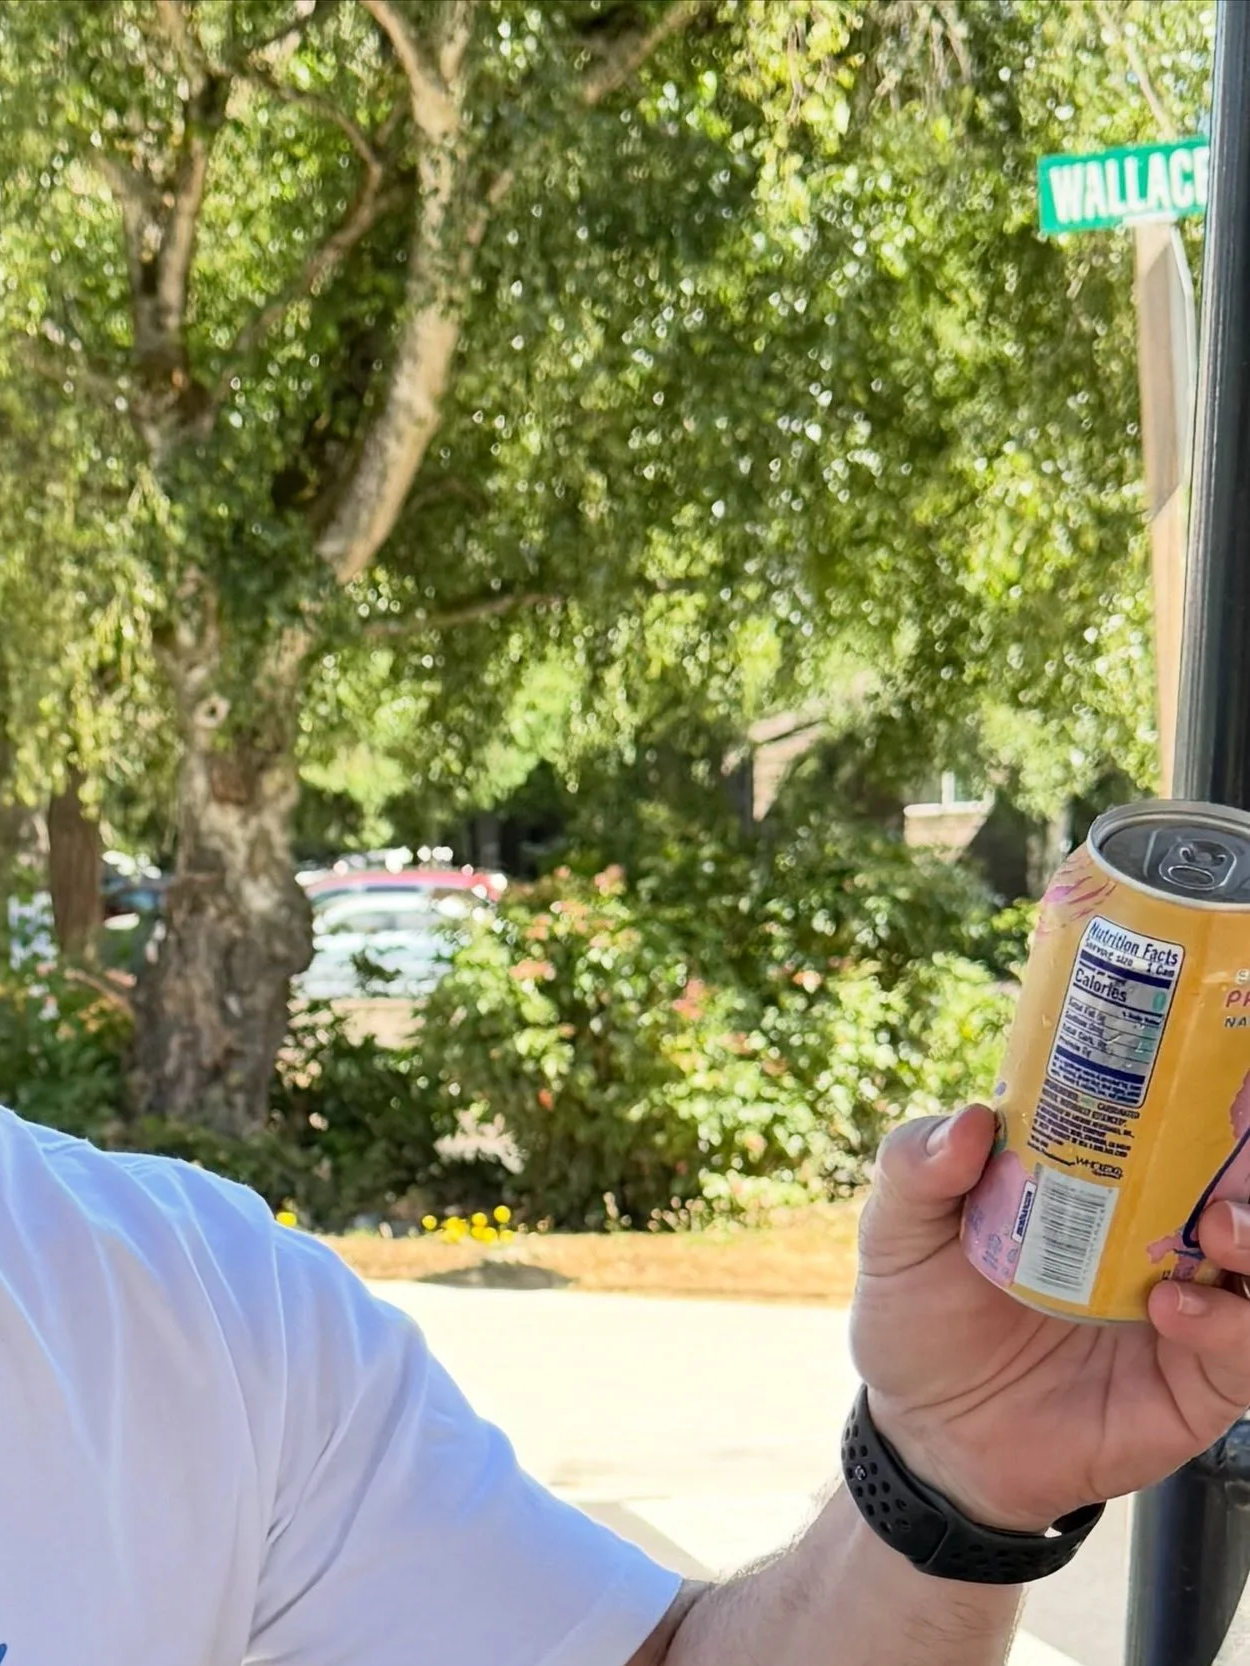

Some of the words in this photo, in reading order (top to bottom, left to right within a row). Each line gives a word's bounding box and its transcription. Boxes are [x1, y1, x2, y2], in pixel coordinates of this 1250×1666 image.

[1089, 920, 1140, 956] Nutrition
[1143, 944, 1178, 966] Facts
[1075, 968, 1127, 1003] Calories
